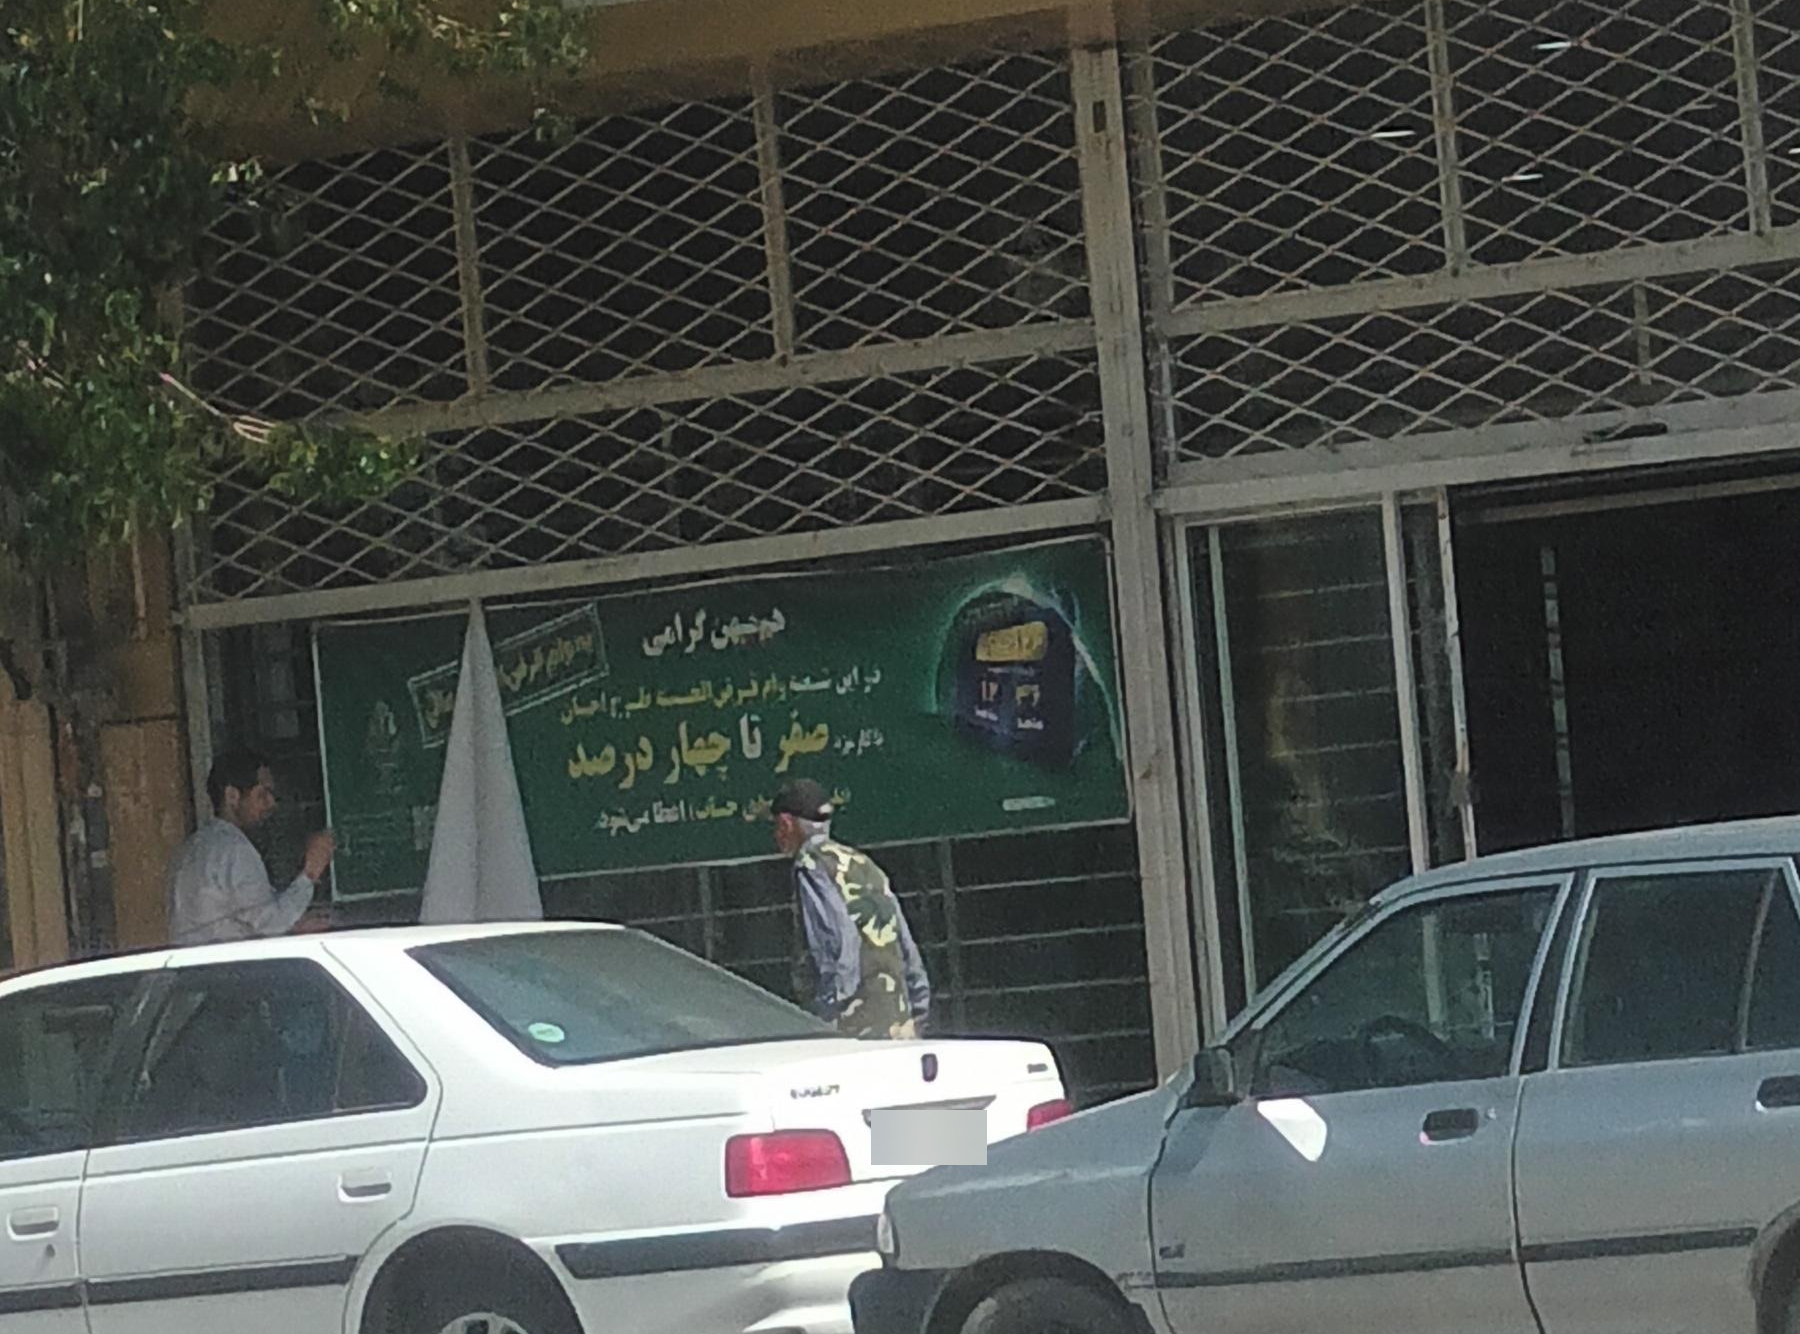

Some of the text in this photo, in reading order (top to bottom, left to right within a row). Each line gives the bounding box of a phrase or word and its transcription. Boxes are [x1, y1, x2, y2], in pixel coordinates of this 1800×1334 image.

[641, 607, 707, 657] گرامی
[567, 735, 654, 790] درصد
[663, 720, 732, 784] چهار
[739, 712, 763, 759] تا
[774, 710, 830, 773] صفر
